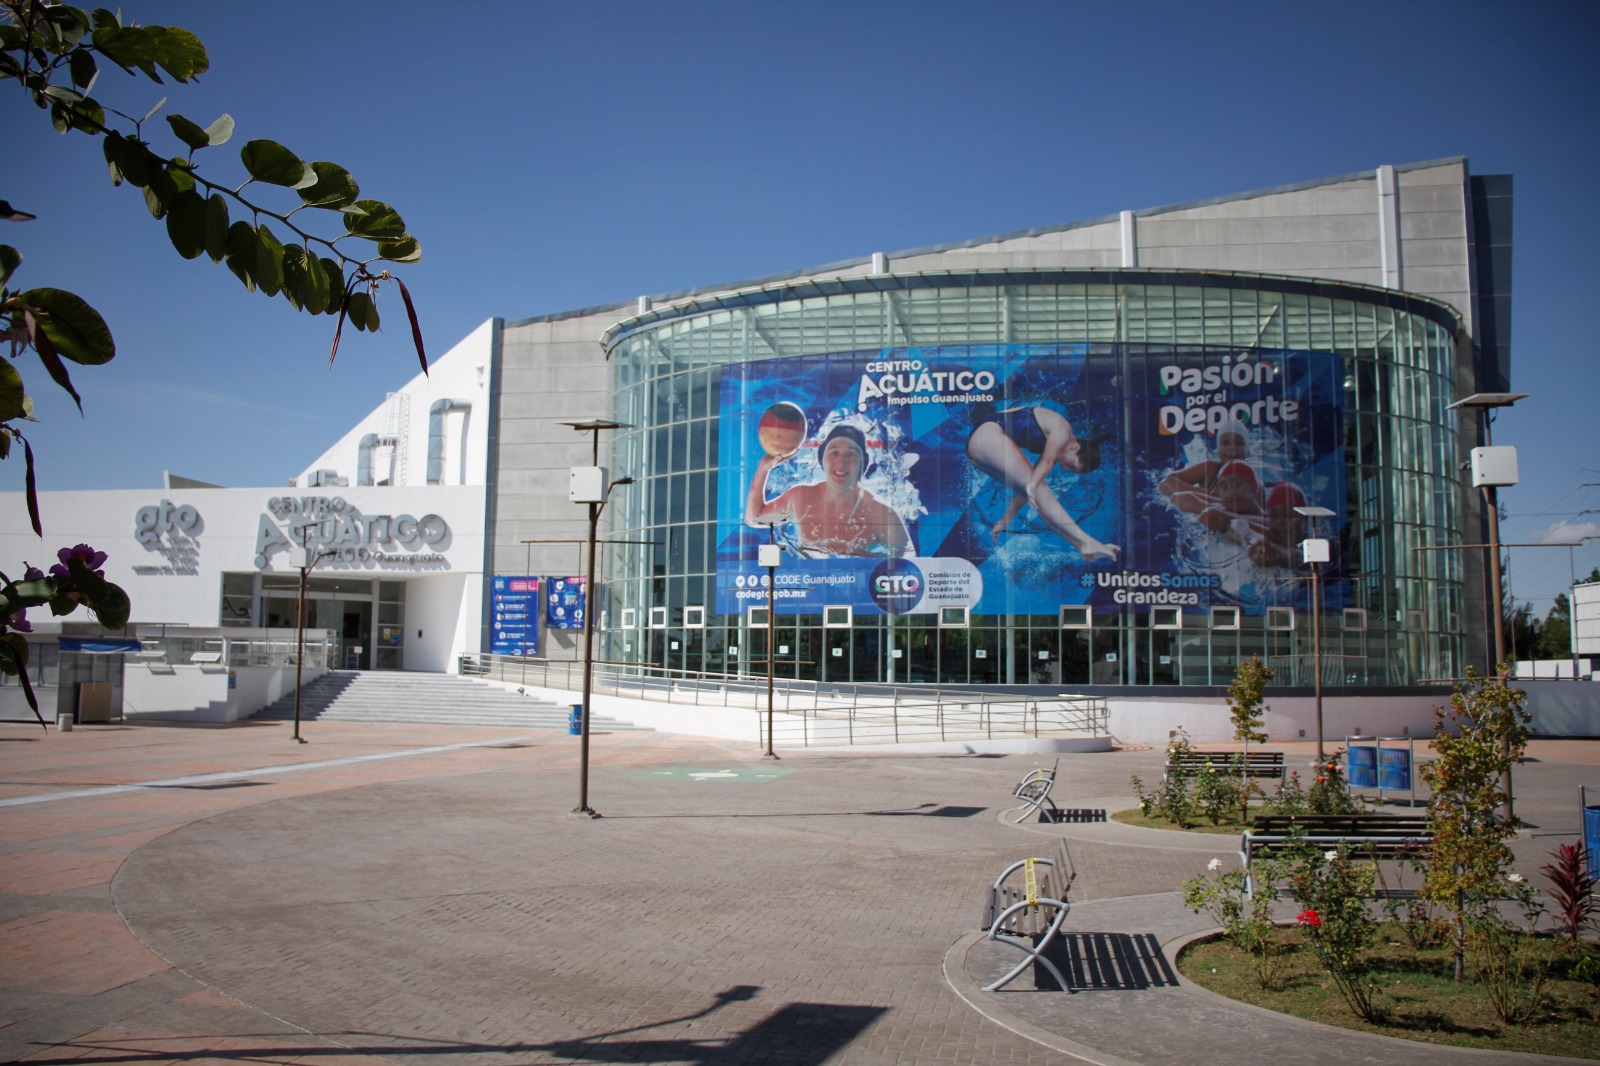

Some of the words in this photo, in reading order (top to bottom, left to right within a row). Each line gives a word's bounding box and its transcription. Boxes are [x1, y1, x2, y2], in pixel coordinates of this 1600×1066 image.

[865, 360, 922, 373] CENTRO
[1159, 352, 1274, 396] Pasión
[857, 367, 995, 408] ACUÁTICO
[887, 394, 930, 406] Impulso
[931, 392, 994, 404] Guanajuato
[1186, 394, 1211, 410] por
[1213, 389, 1227, 403] el
[1158, 395, 1299, 438] Deporte
[267, 496, 347, 513] CENTRO
[134, 499, 199, 545] gto
[774, 575, 801, 584] CODE
[803, 574, 856, 587] Guanajuato
[928, 571, 960, 579] Comisión
[928, 579, 957, 587] Deporte
[1081, 570, 1220, 588] #UnidosSomos
[874, 575, 919, 593] GTO
[735, 588, 807, 600] codegtogob.mx
[1112, 589, 1199, 604] Grandeza
